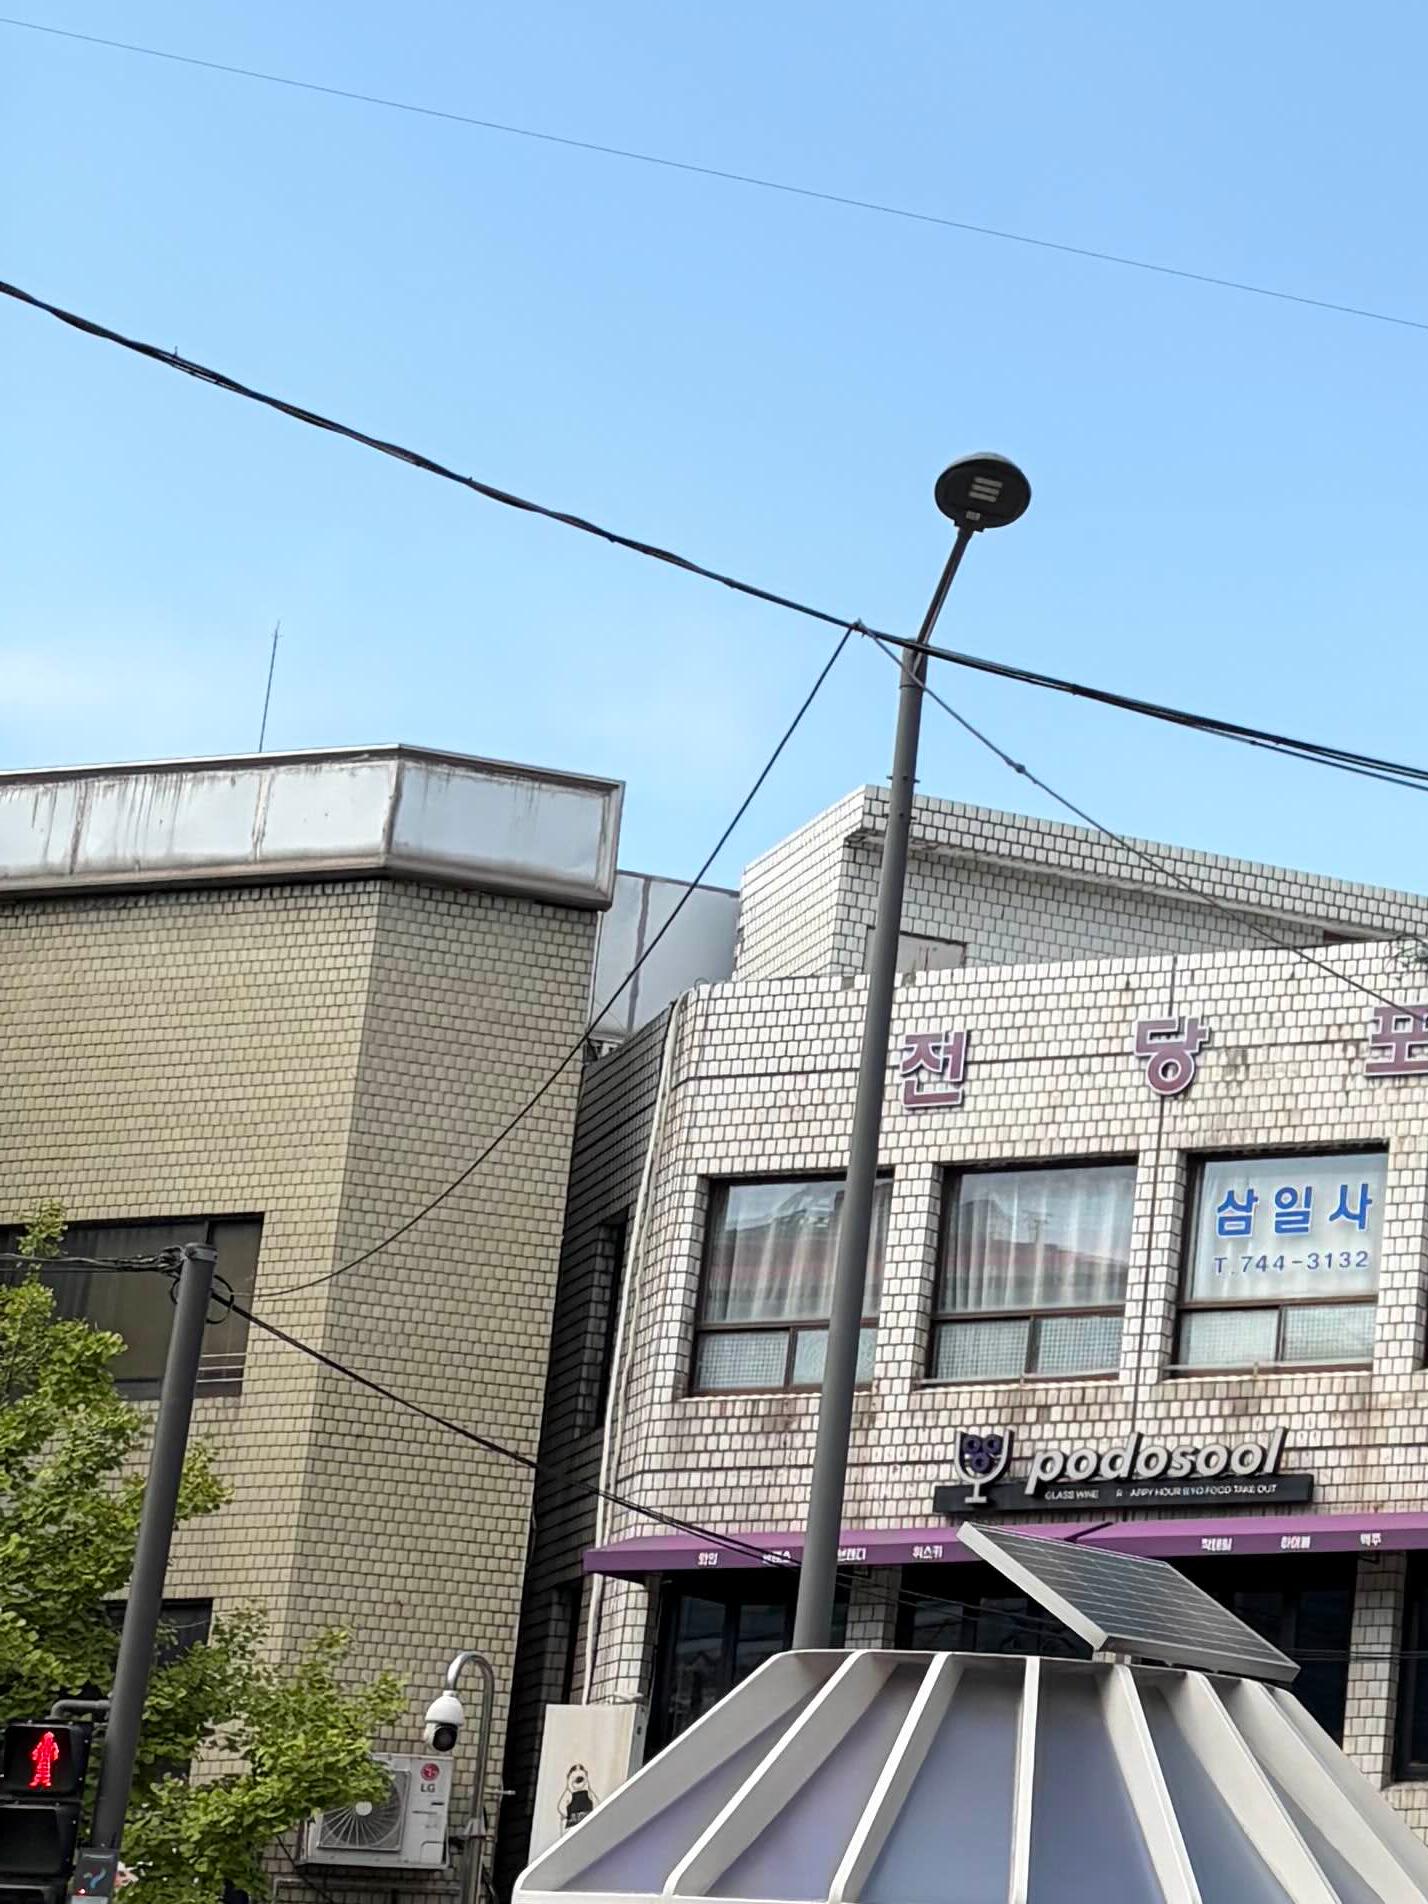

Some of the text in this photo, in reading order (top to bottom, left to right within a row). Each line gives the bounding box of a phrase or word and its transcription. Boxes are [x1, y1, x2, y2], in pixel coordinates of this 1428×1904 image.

[1216, 1182, 1376, 1239] 삼일사
[1214, 1250, 1370, 1275] T.744-3132
[1025, 1426, 1287, 1495] podosool
[912, 1545, 943, 1559] 위스키
[420, 1782, 436, 1793] LG
